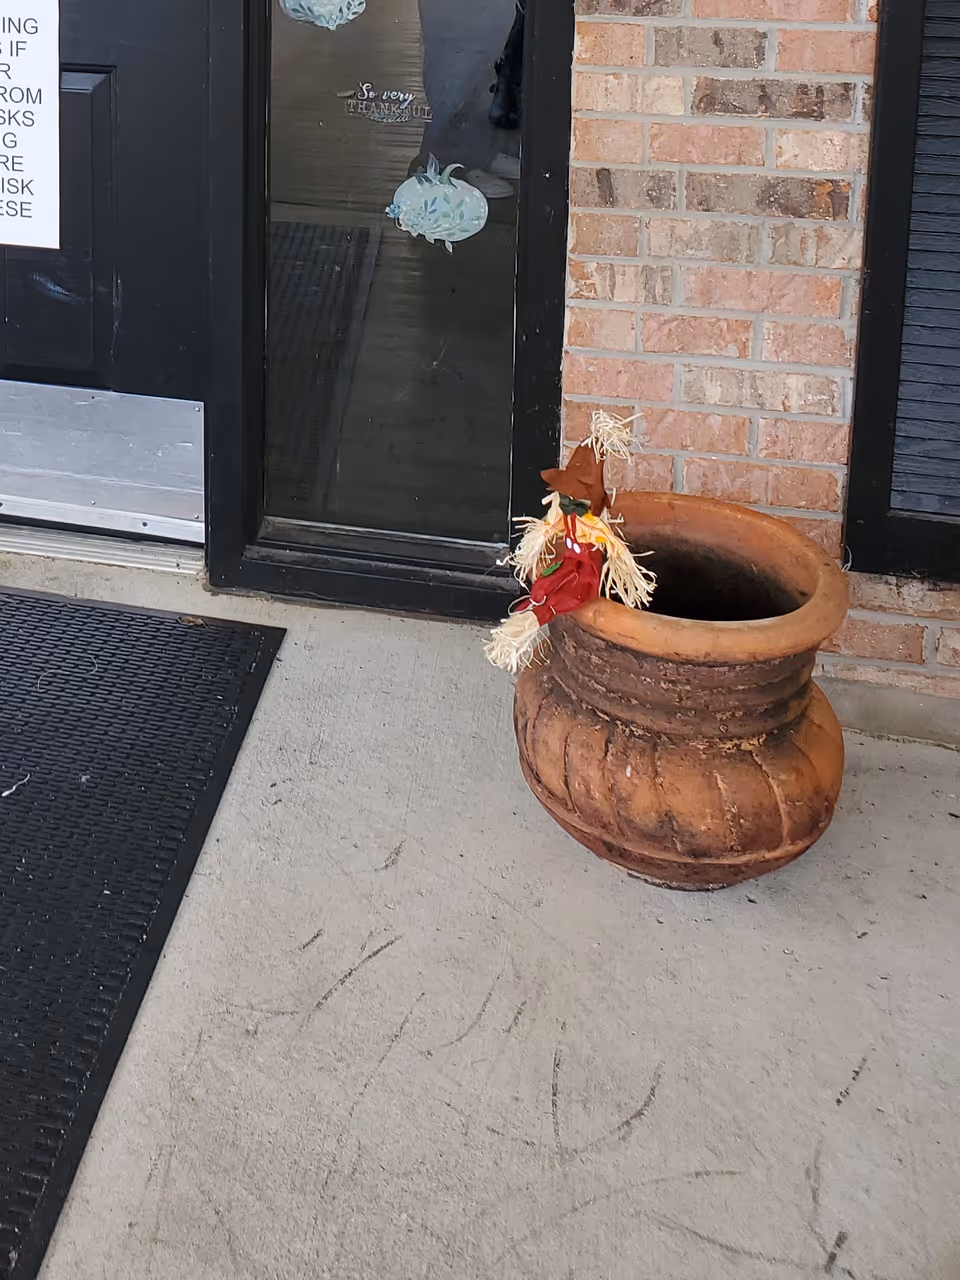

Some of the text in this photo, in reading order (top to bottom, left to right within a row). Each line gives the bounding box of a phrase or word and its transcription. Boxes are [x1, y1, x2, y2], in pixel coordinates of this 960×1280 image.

[10, 40, 27, 57] IF
[357, 81, 417, 109] So very
